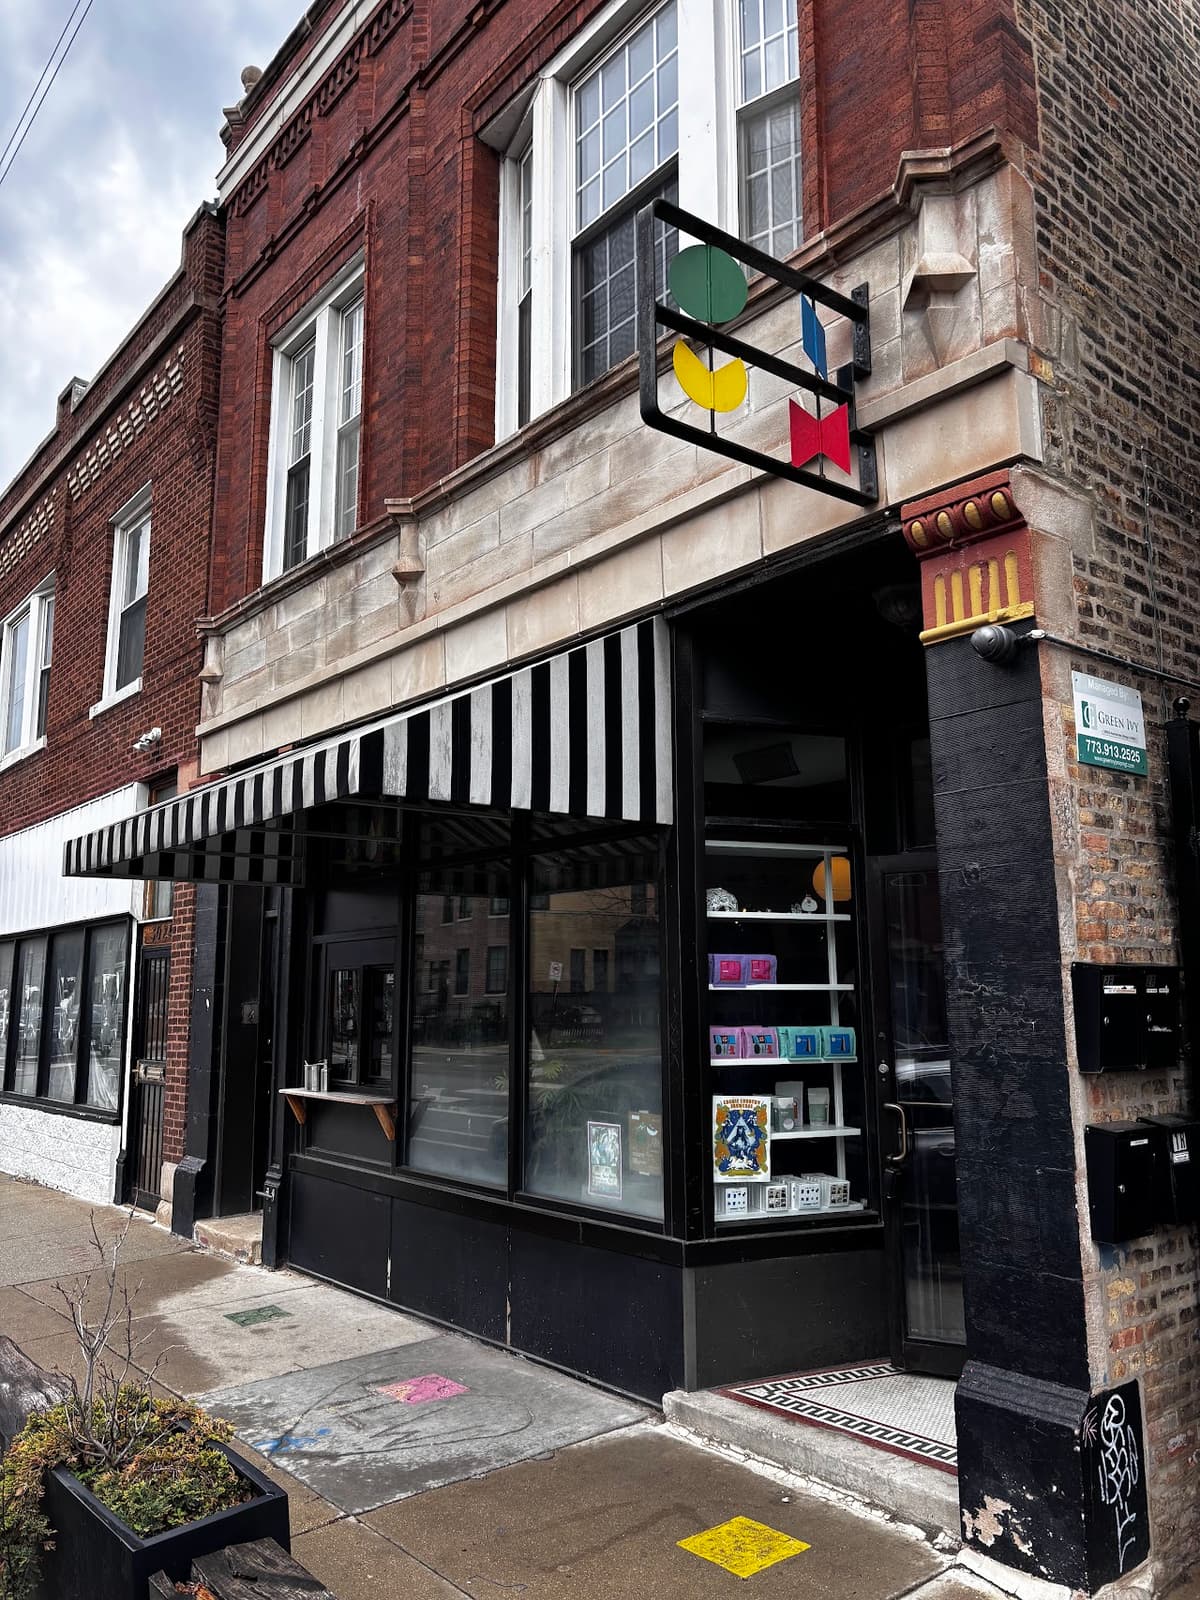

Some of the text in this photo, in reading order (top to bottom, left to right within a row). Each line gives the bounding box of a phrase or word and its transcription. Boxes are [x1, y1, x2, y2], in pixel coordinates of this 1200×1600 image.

[1087, 678, 1118, 697] Managed
[1098, 710, 1125, 729] GREEN
[1126, 718, 1139, 733] IVY
[1085, 739, 1141, 763] 773.913.2525
